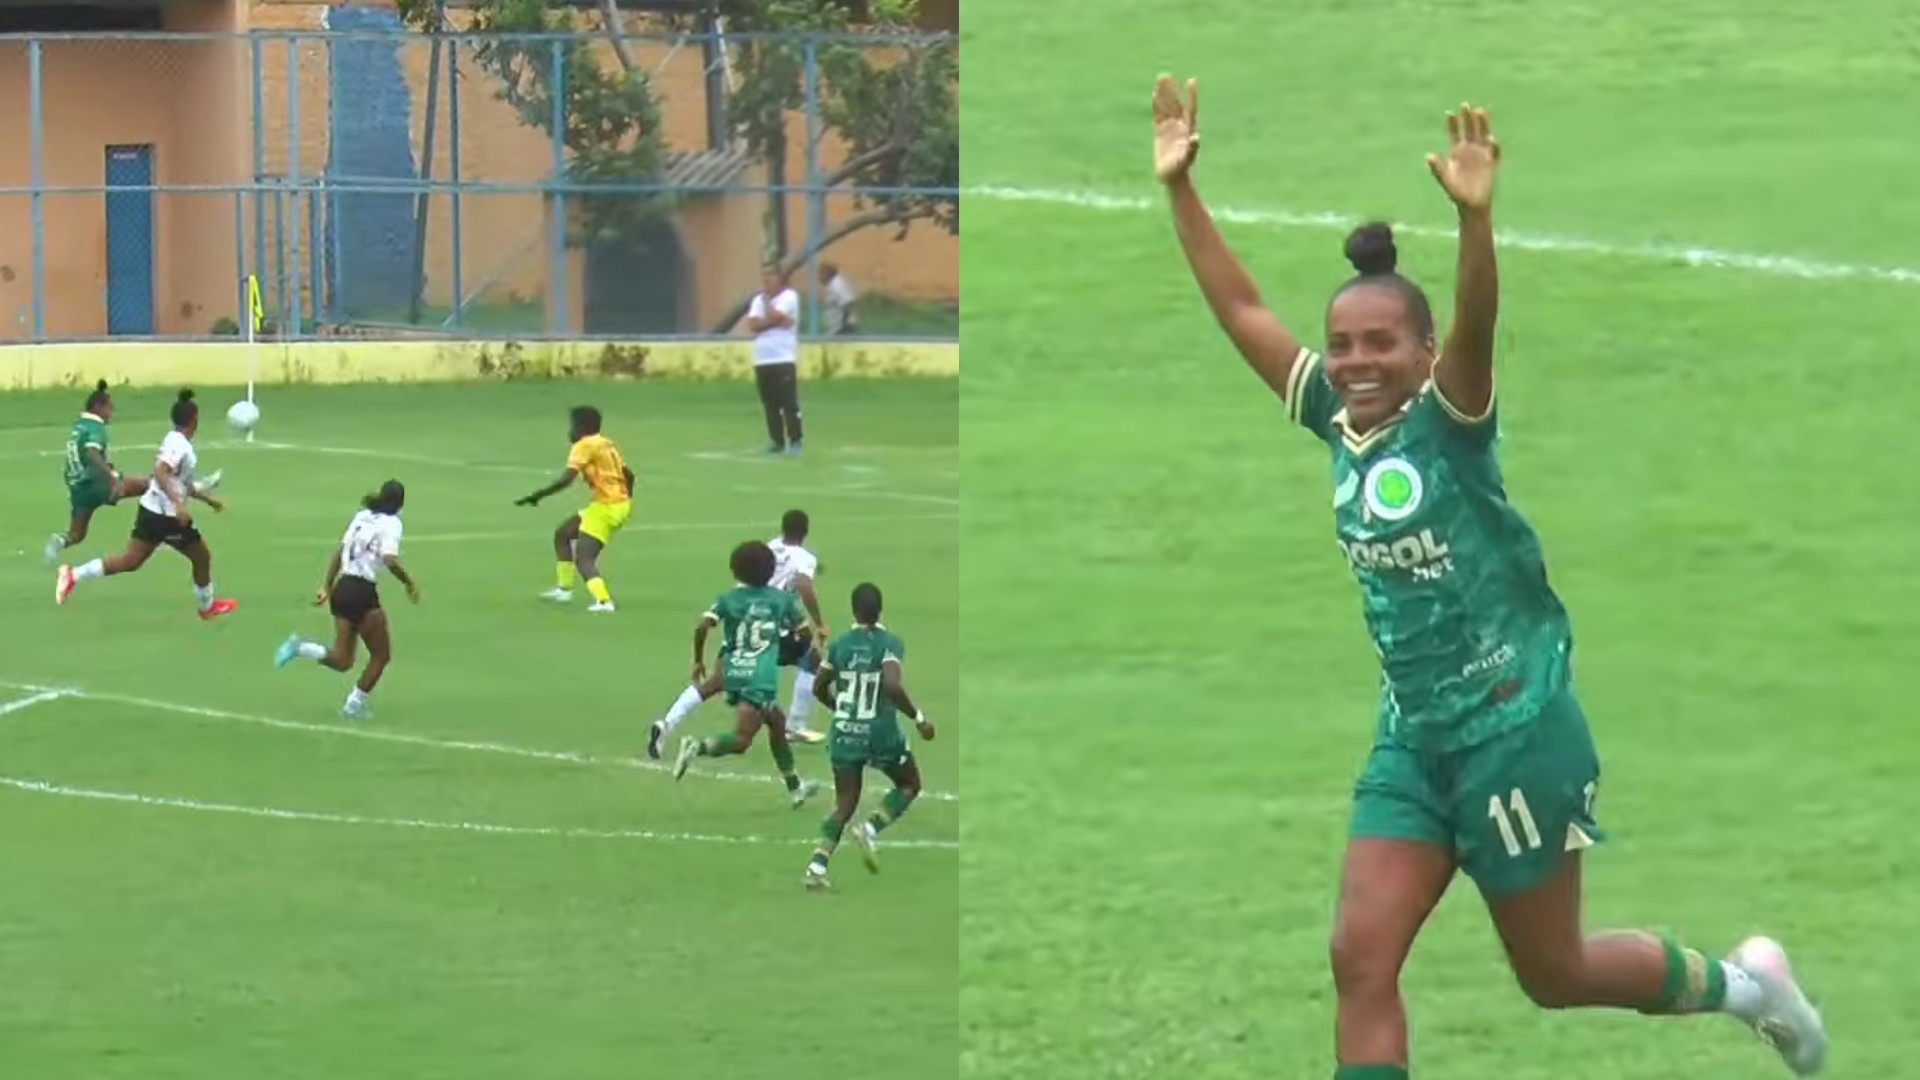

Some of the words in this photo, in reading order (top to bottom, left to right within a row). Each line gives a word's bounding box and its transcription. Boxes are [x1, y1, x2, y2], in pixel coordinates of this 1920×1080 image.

[733, 621, 776, 657] 15
[835, 671, 880, 719] 20
[1488, 788, 1541, 857] 11
